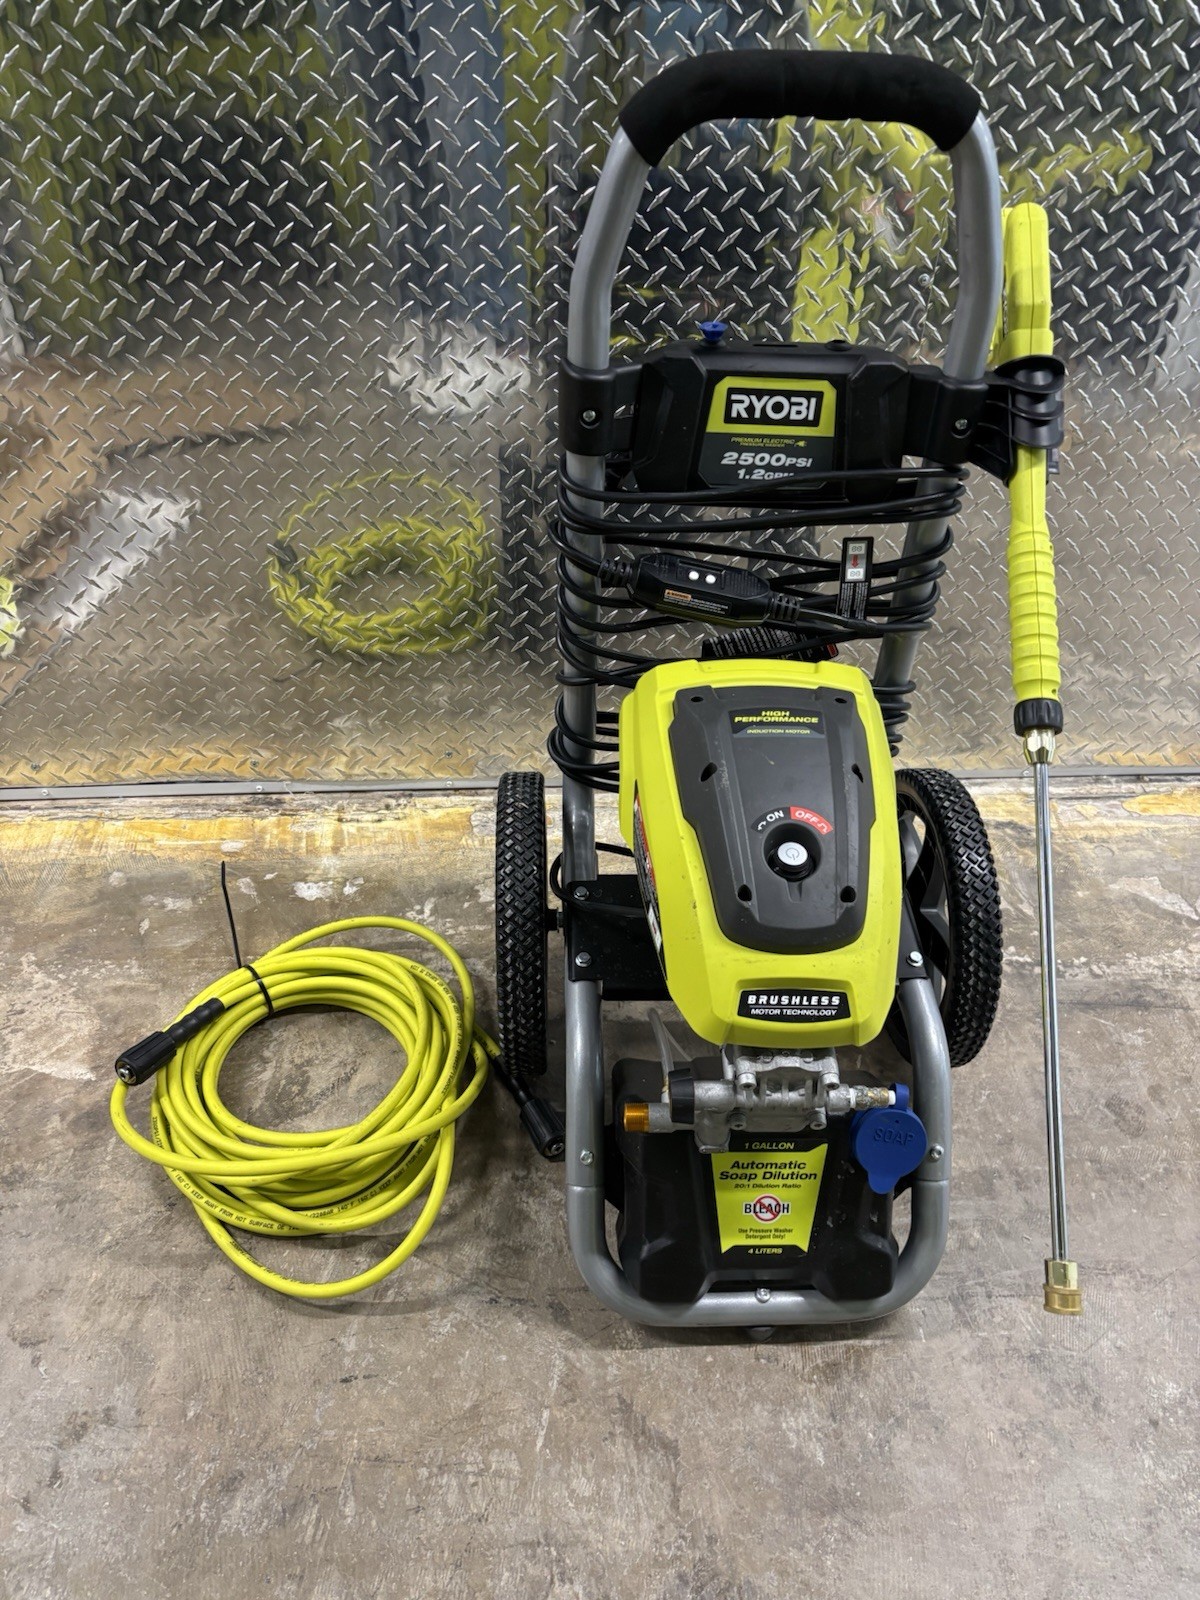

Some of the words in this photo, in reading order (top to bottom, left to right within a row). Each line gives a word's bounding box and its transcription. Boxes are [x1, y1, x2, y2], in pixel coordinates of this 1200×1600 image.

[730, 393, 817, 421] RYOBI
[730, 436, 762, 444] PREMIUM
[762, 437, 796, 445] ELECTRIC
[720, 451, 813, 468] 2500PSI
[734, 716, 819, 724] PERFORMANCE
[766, 810, 785, 822] ON
[795, 810, 820, 824] OFF
[747, 994, 841, 1006] BRUSHLESS
[750, 1008, 781, 1016] MOTOR
[782, 1008, 838, 1017] TECHNOLOGY
[873, 1128, 915, 1146] SOAP
[744, 1142, 750, 1150] 1
[751, 1141, 795, 1150] GALLON
[730, 1160, 807, 1170] Automatic
[718, 1171, 758, 1182] Soap
[762, 1171, 817, 1180] Dilution
[744, 1202, 790, 1215] BLEACH
[235, 1214, 247, 1223] HOT
[248, 1219, 275, 1230] SURFACE
[748, 1247, 754, 1255] 4
[755, 1247, 783, 1255] LITERS
